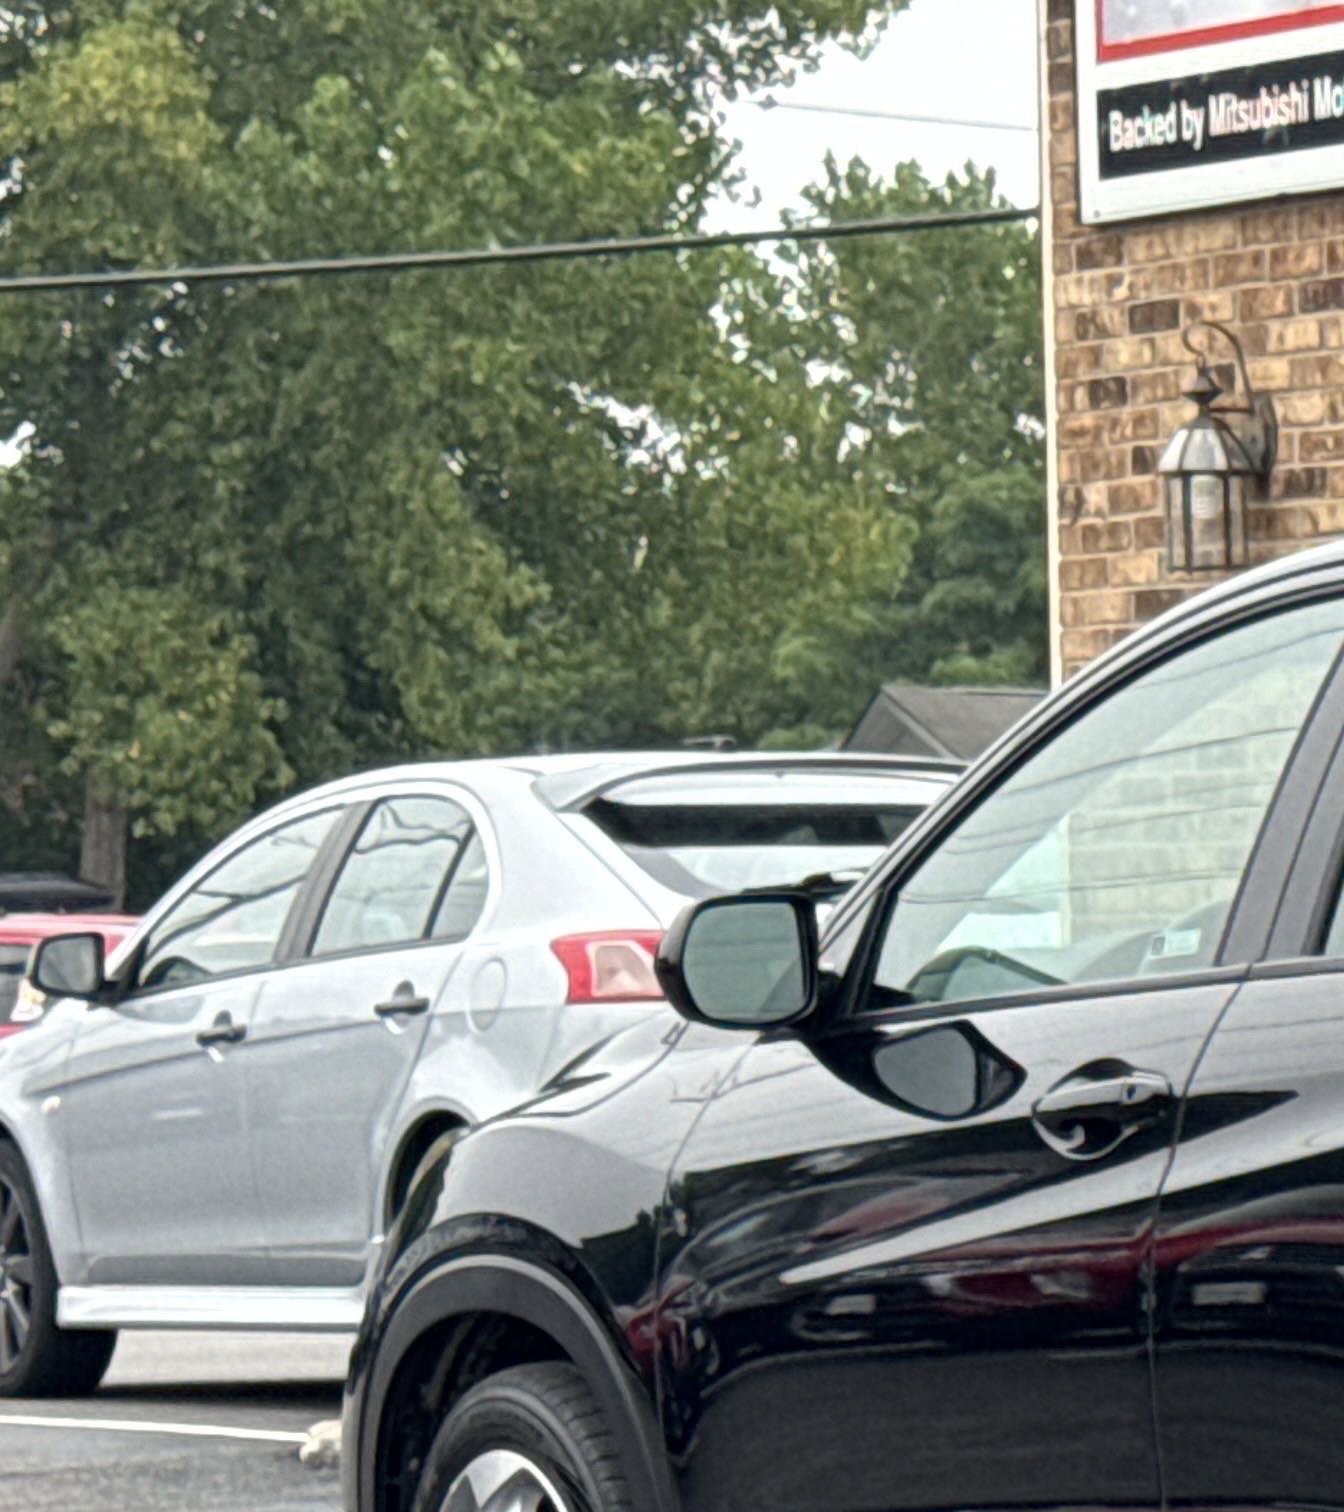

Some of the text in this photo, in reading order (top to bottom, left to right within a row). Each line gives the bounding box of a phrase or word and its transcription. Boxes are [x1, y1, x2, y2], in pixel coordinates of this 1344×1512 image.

[1107, 106, 1177, 153] Backed
[1181, 99, 1205, 151] by
[1208, 79, 1309, 135] Mitsubishi
